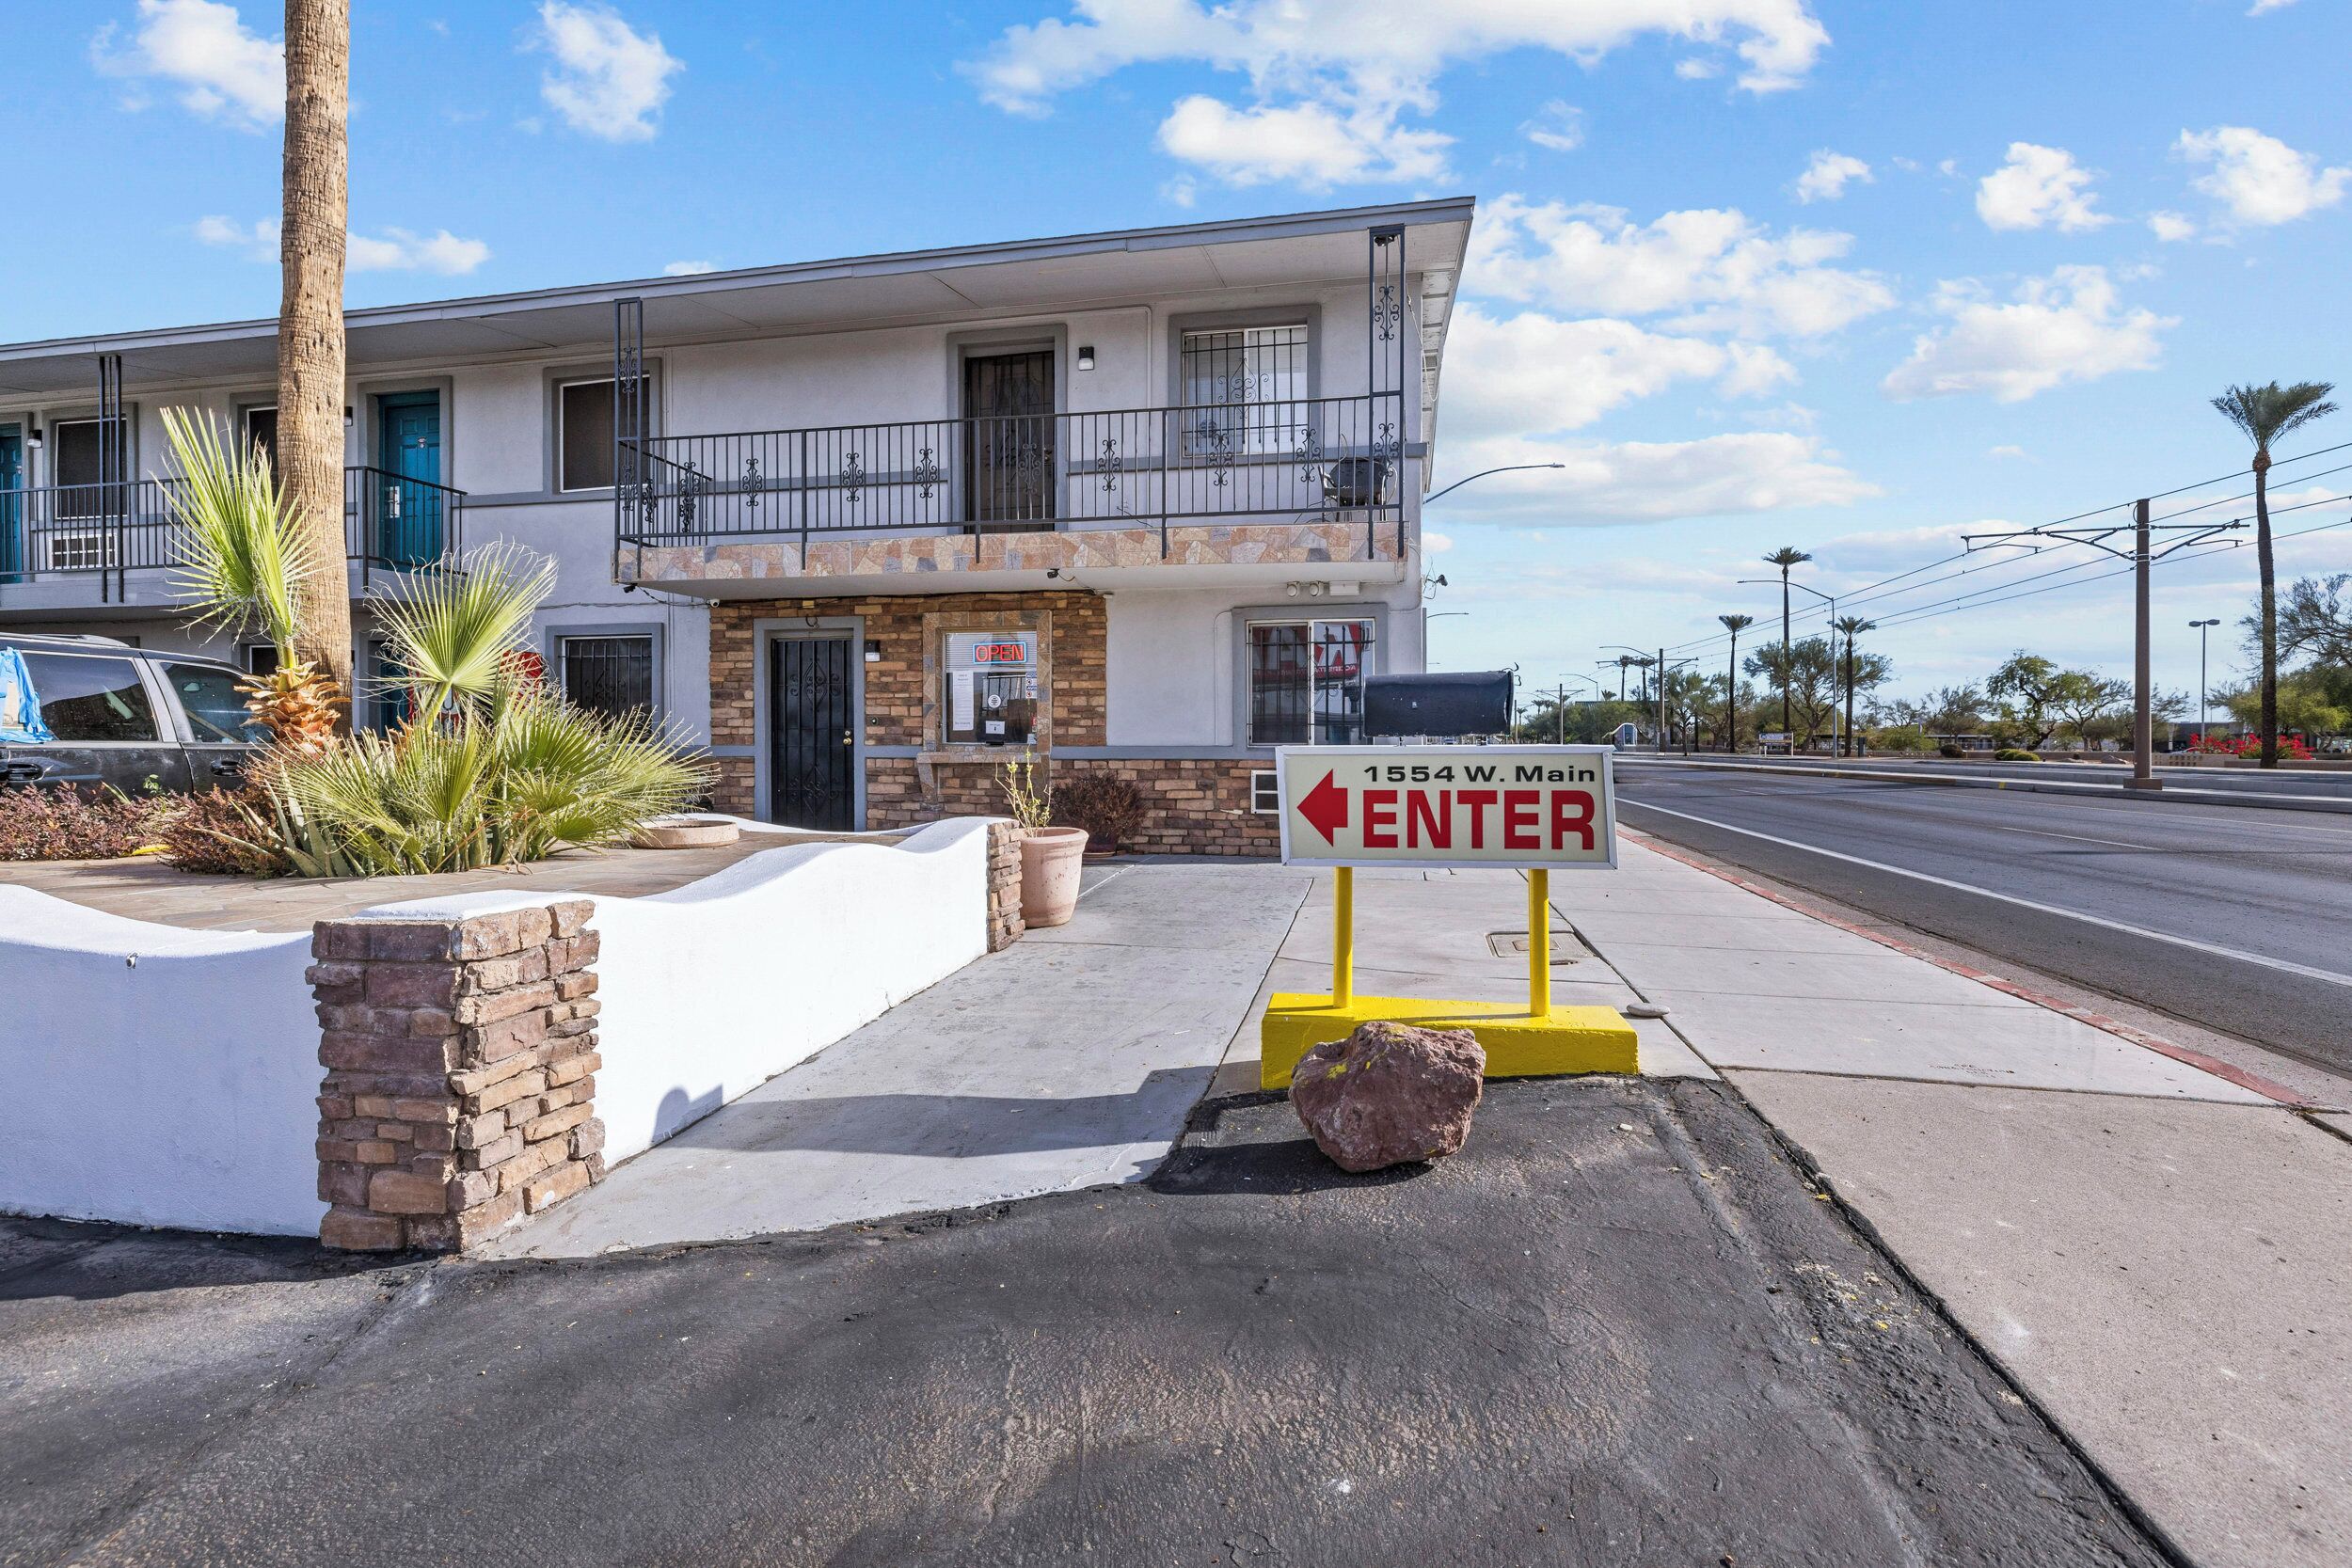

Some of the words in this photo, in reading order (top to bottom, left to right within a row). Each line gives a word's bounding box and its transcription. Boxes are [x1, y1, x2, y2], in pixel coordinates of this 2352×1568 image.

[976, 644, 1024, 661] OPEN
[1363, 766, 1455, 783] 1554
[1464, 766, 1505, 783] W.
[1516, 766, 1596, 783] Main
[1362, 789, 1596, 850] ENTER
